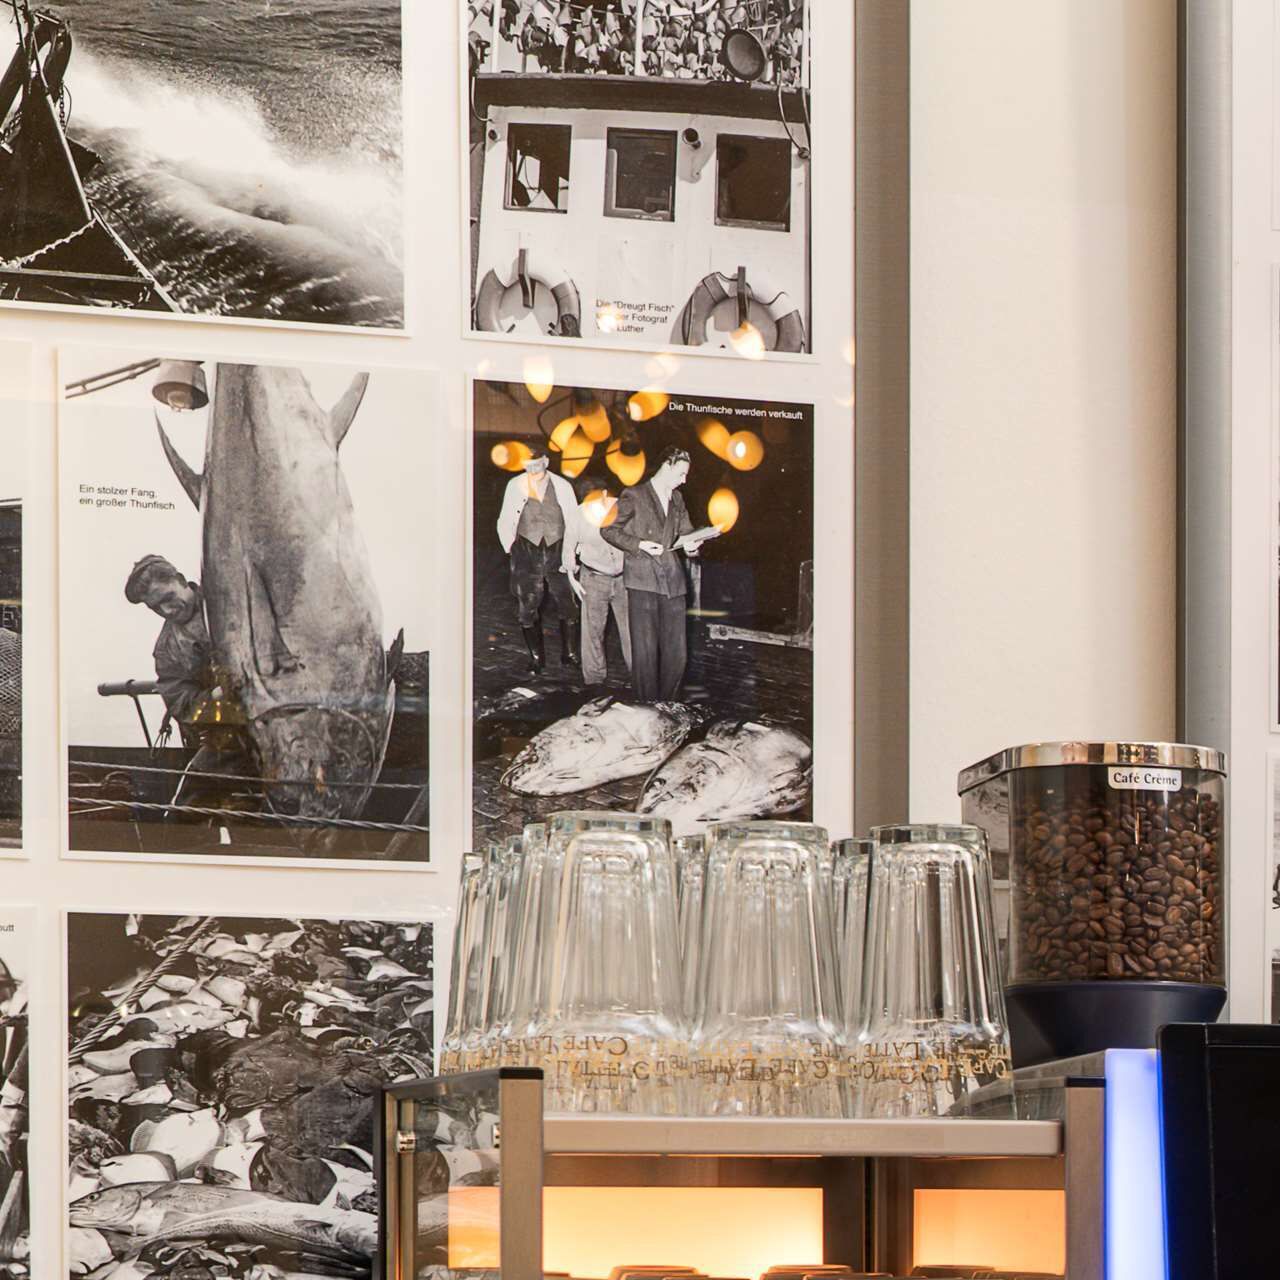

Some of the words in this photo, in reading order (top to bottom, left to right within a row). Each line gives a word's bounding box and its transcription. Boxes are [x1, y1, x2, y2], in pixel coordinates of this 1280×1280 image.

[668, 401, 684, 411] Die
[685, 403, 733, 415] Thunfische
[734, 407, 767, 417] werden
[768, 410, 804, 420] verkauft
[79, 484, 95, 494] Ein
[97, 486, 128, 496] stolzer
[79, 497, 94, 505] ein
[95, 498, 128, 508] großer
[130, 499, 176, 510] Thunfisch
[1113, 771, 1140, 784] Café
[1144, 773, 1177, 785] Crème
